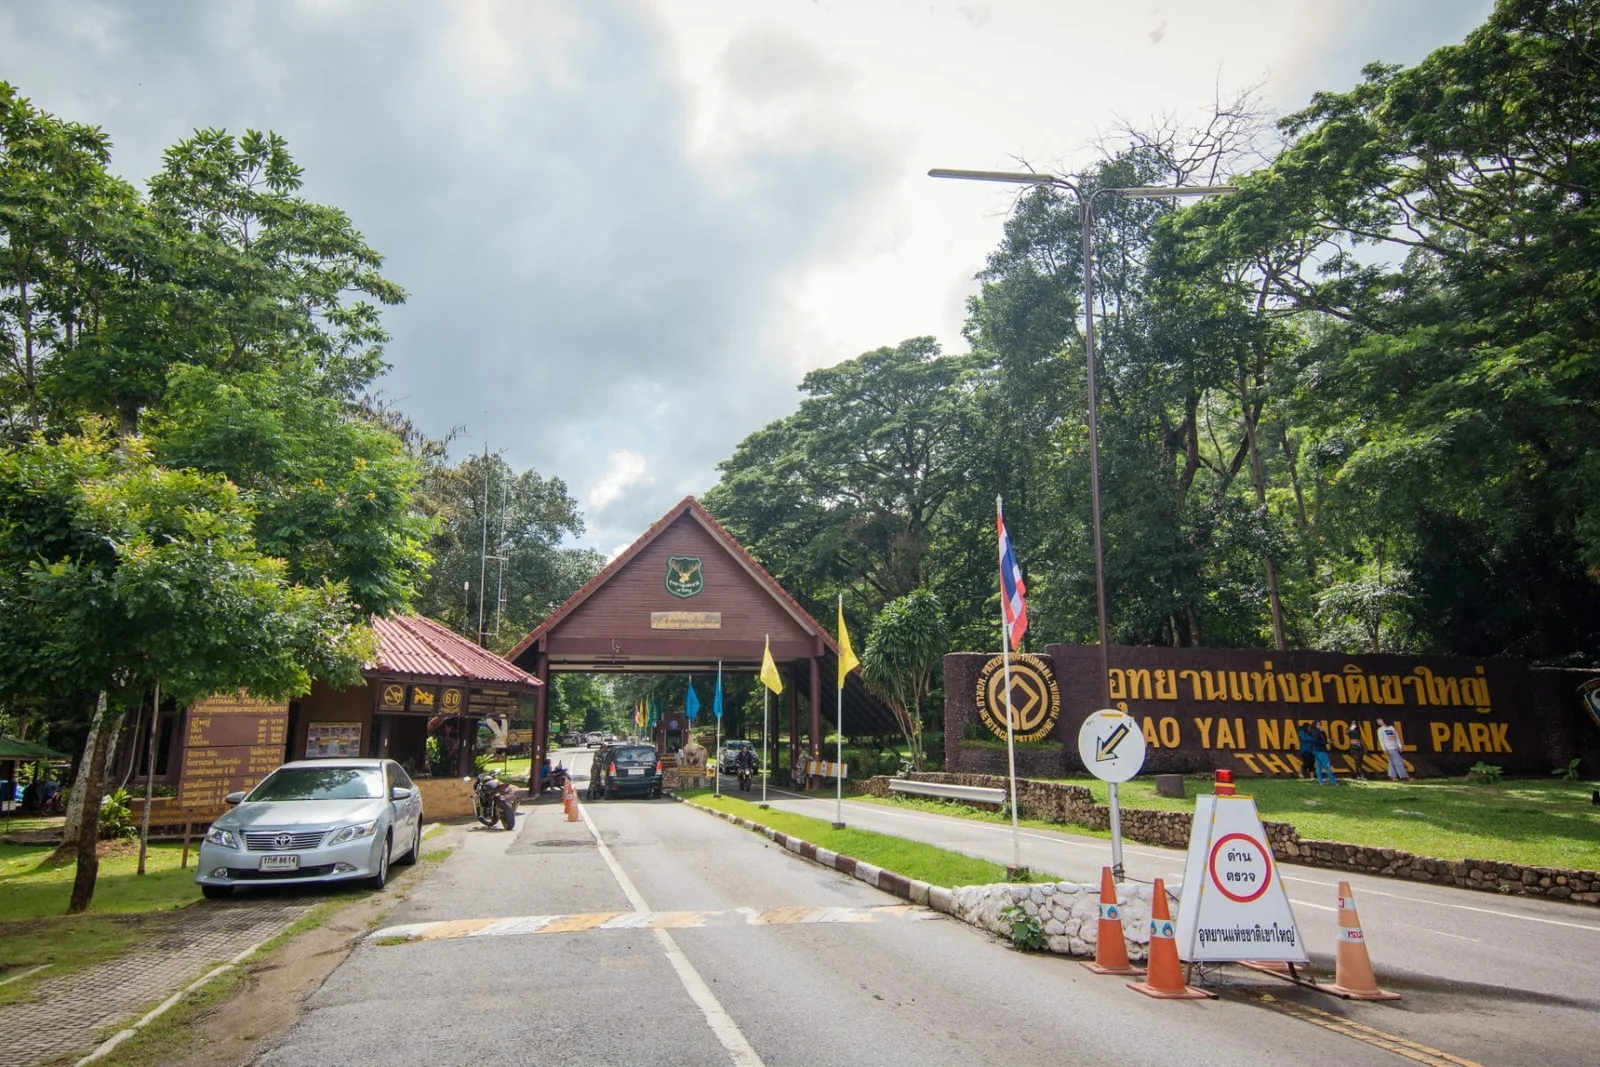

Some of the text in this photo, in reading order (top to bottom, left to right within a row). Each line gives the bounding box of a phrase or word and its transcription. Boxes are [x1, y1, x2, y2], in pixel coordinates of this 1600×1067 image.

[1108, 660, 1491, 714] อุทยานแห่งชาติเขาใหญ่
[445, 693, 459, 704] 60
[1141, 716, 1181, 748] AO
[1194, 717, 1247, 749] YAI
[1430, 721, 1513, 753] PARK
[1227, 848, 1252, 862] ด่าน
[1226, 871, 1256, 882] ตรวจ
[1198, 922, 1295, 948] อุทยานแห่งชาติเขาใหญ่
